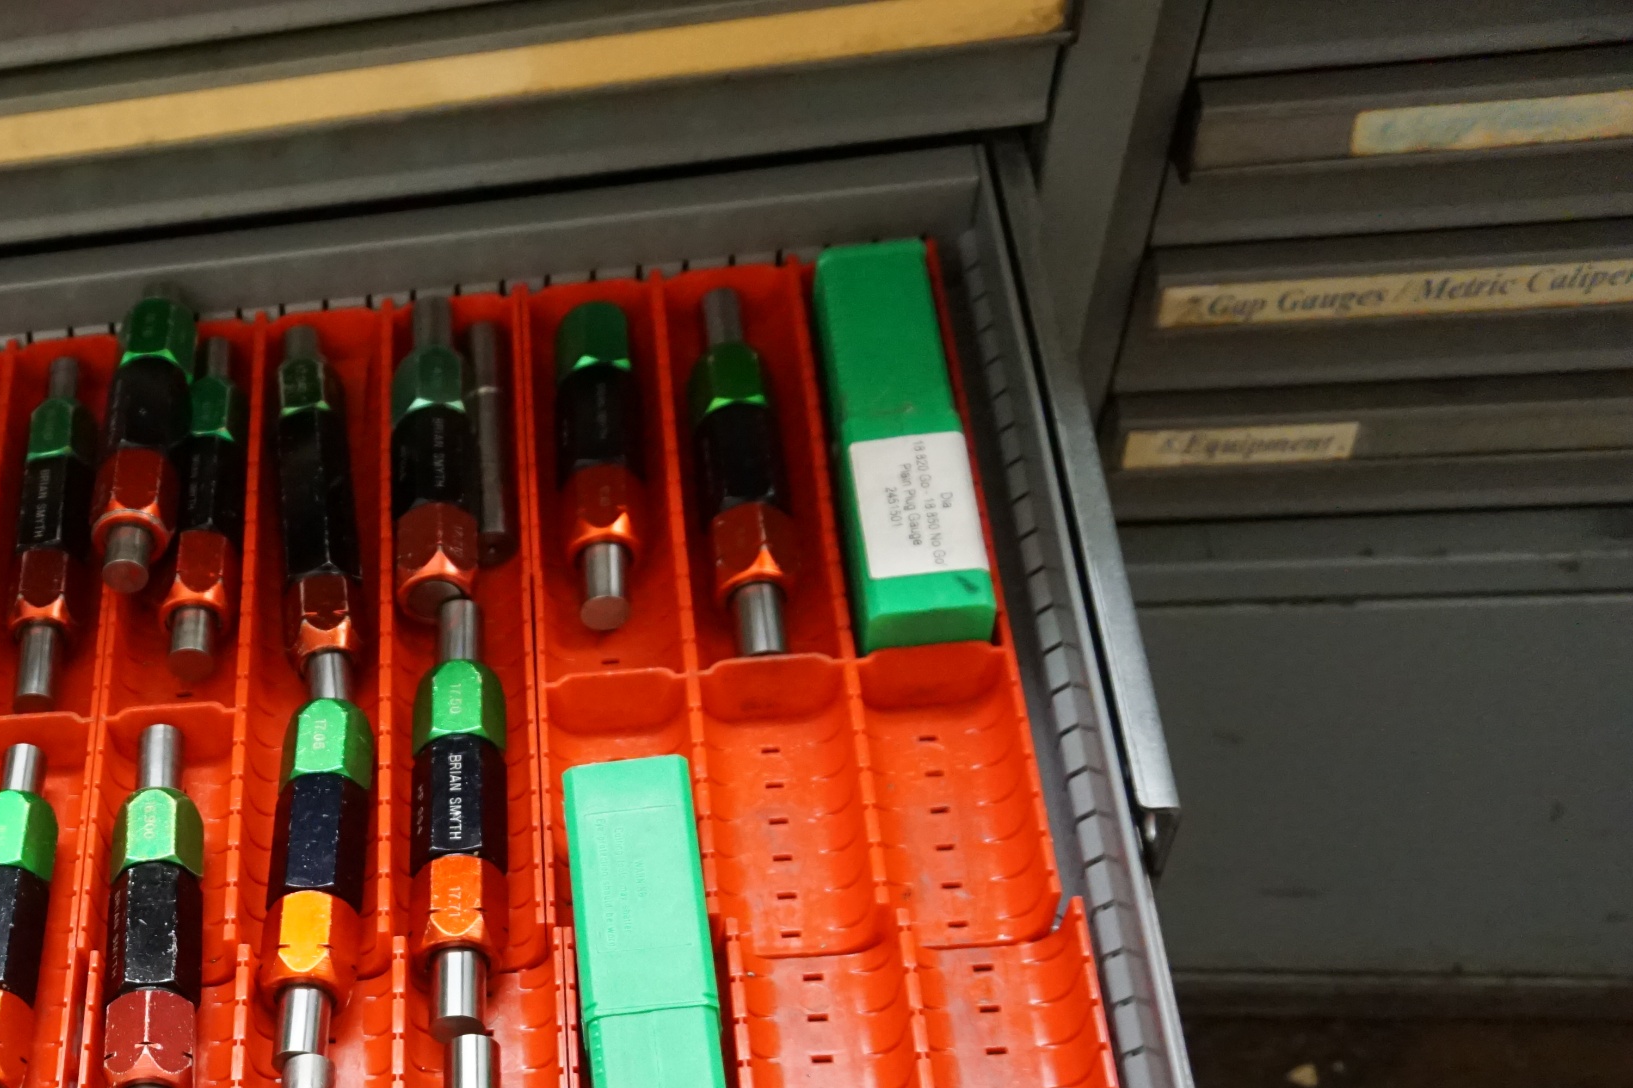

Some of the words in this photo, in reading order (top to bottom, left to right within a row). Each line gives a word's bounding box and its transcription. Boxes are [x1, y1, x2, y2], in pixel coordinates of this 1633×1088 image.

[1209, 293, 1267, 319] Gap
[1277, 287, 1384, 314] Gauges
[1413, 273, 1511, 301] Metric
[37, 468, 51, 499] BRIAN
[900, 462, 912, 487] Plain
[903, 489, 917, 511] Plug
[33, 502, 46, 539] SMYTH
[908, 512, 923, 546] Gauge
[448, 753, 463, 791] BRIAN
[449, 797, 463, 840] SMYTH
